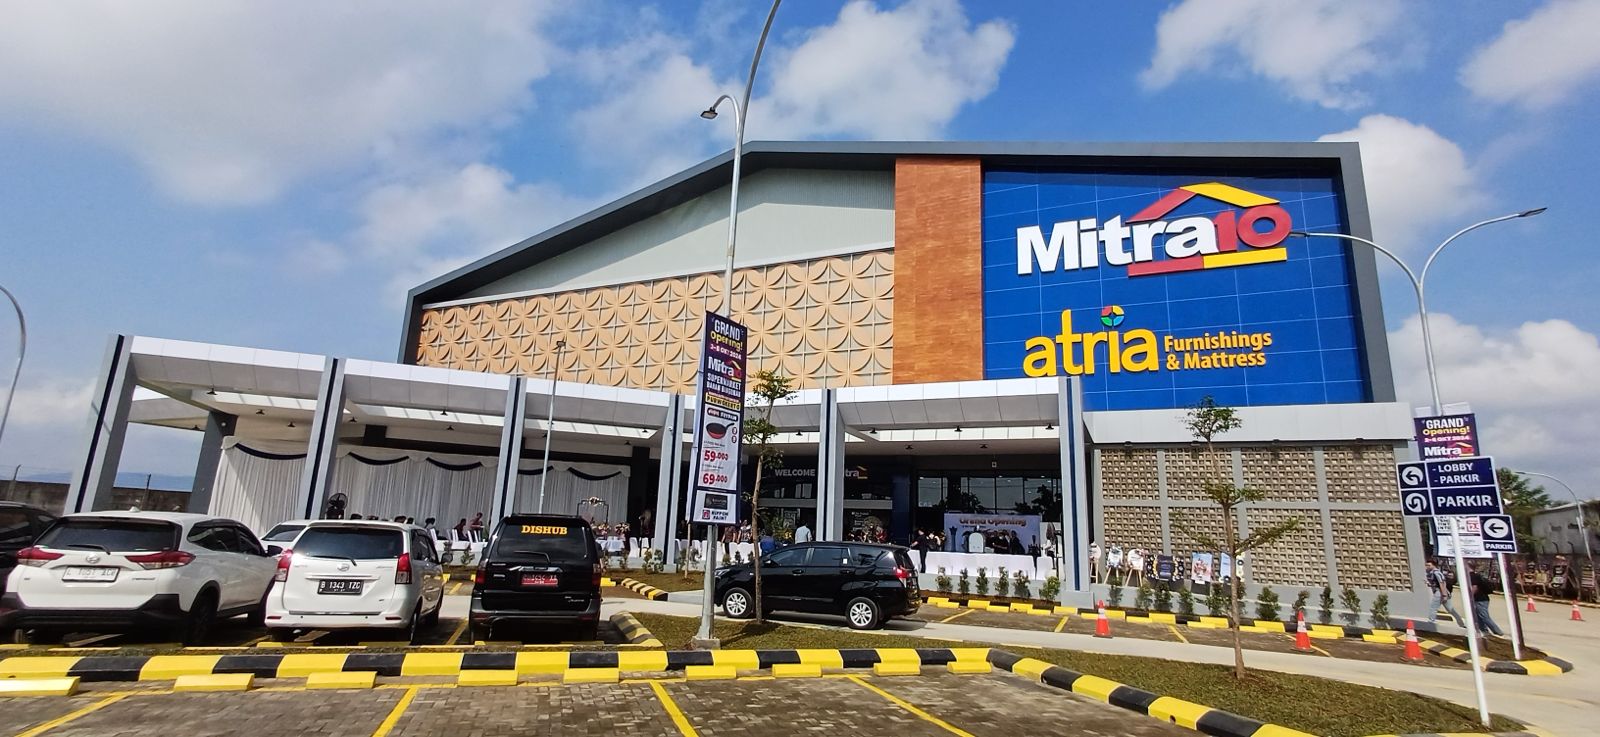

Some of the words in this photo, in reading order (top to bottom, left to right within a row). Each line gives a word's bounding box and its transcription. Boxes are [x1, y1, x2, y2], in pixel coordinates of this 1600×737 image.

[1017, 204, 1292, 275] Mitra10
[714, 319, 740, 340] GRAND
[1022, 305, 1159, 377] atria
[1163, 330, 1272, 353] Furnishings
[1166, 355, 1180, 370] &
[1183, 350, 1267, 370] Mattress
[1426, 418, 1464, 430] GRAND
[775, 469, 816, 477] WELCOME
[1438, 462, 1473, 473] LOBBY
[1440, 474, 1480, 484] PARKIR
[1436, 495, 1493, 507] PARKIR
[959, 517, 987, 525] Grand
[989, 518, 1027, 527] Opening
[521, 525, 568, 535] DISHUB
[320, 581, 326, 589] B
[329, 581, 345, 589] 1343
